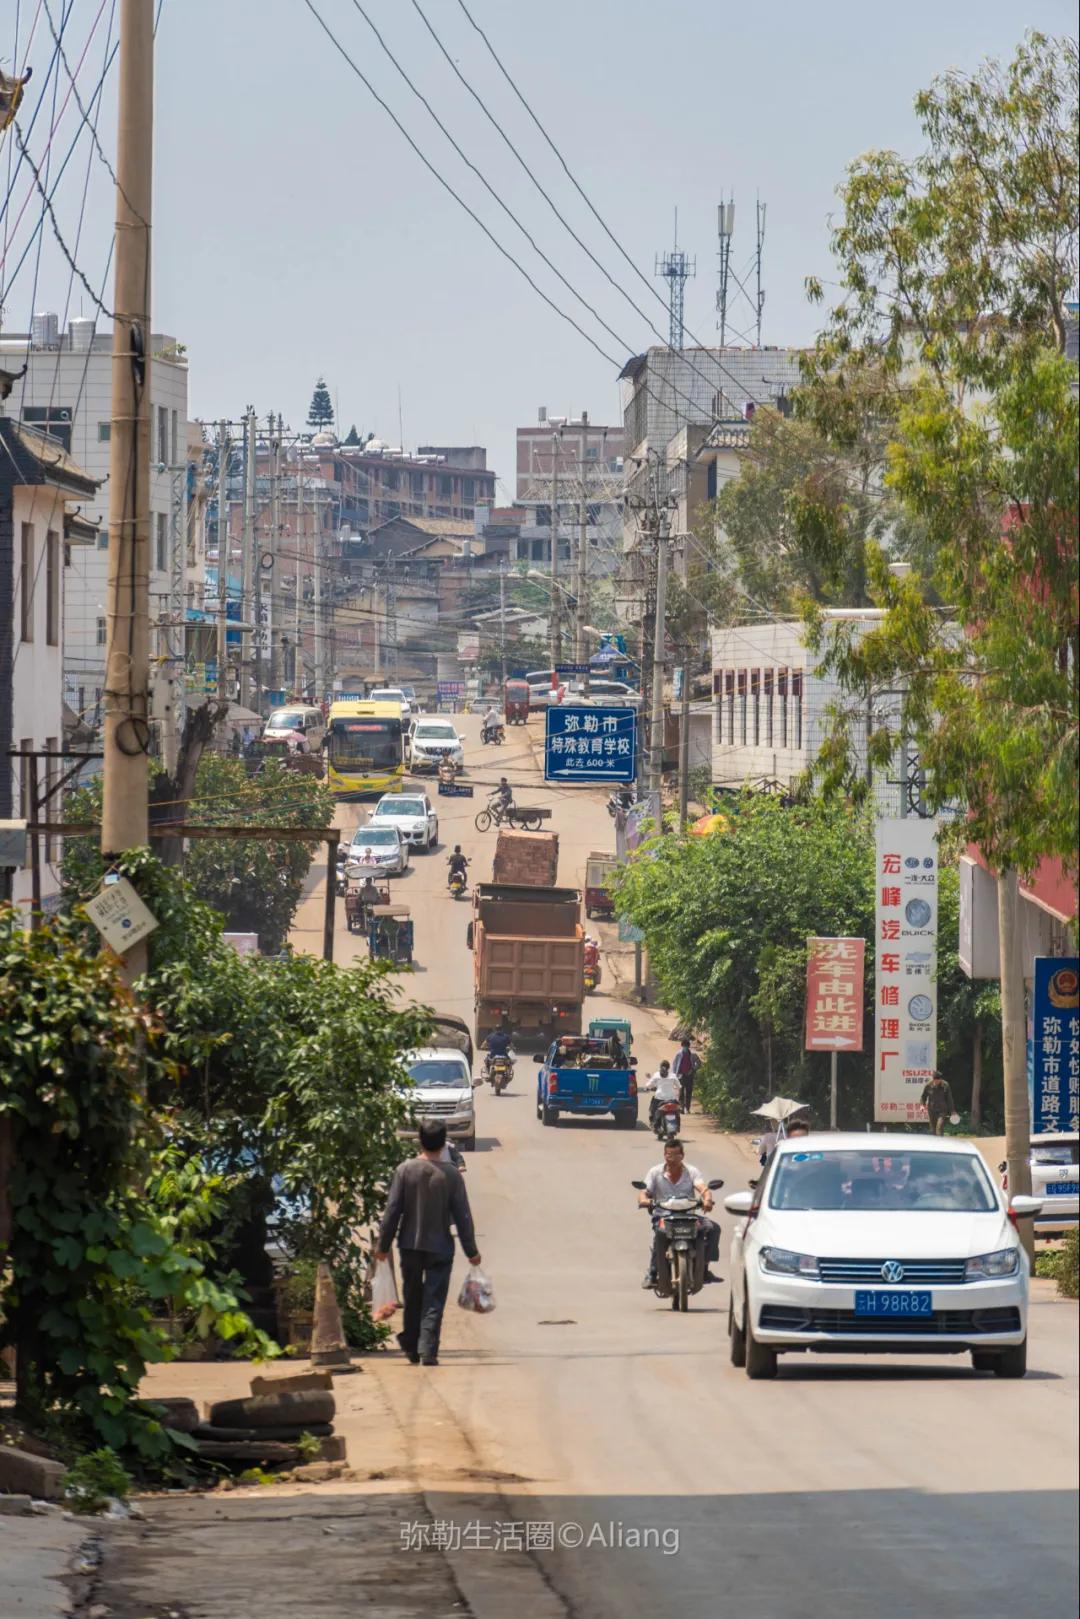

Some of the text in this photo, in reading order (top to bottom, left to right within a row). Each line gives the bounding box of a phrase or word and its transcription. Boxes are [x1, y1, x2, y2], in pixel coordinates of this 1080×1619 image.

[551, 736, 630, 755] 特殊教育学校
[564, 714, 618, 733] 弥勒市
[814, 943, 857, 1032] 洗车由此进
[880, 853, 901, 1071] 宏峰汽车修理厂
[1041, 1016, 1061, 1132] 弥勒市道路交
